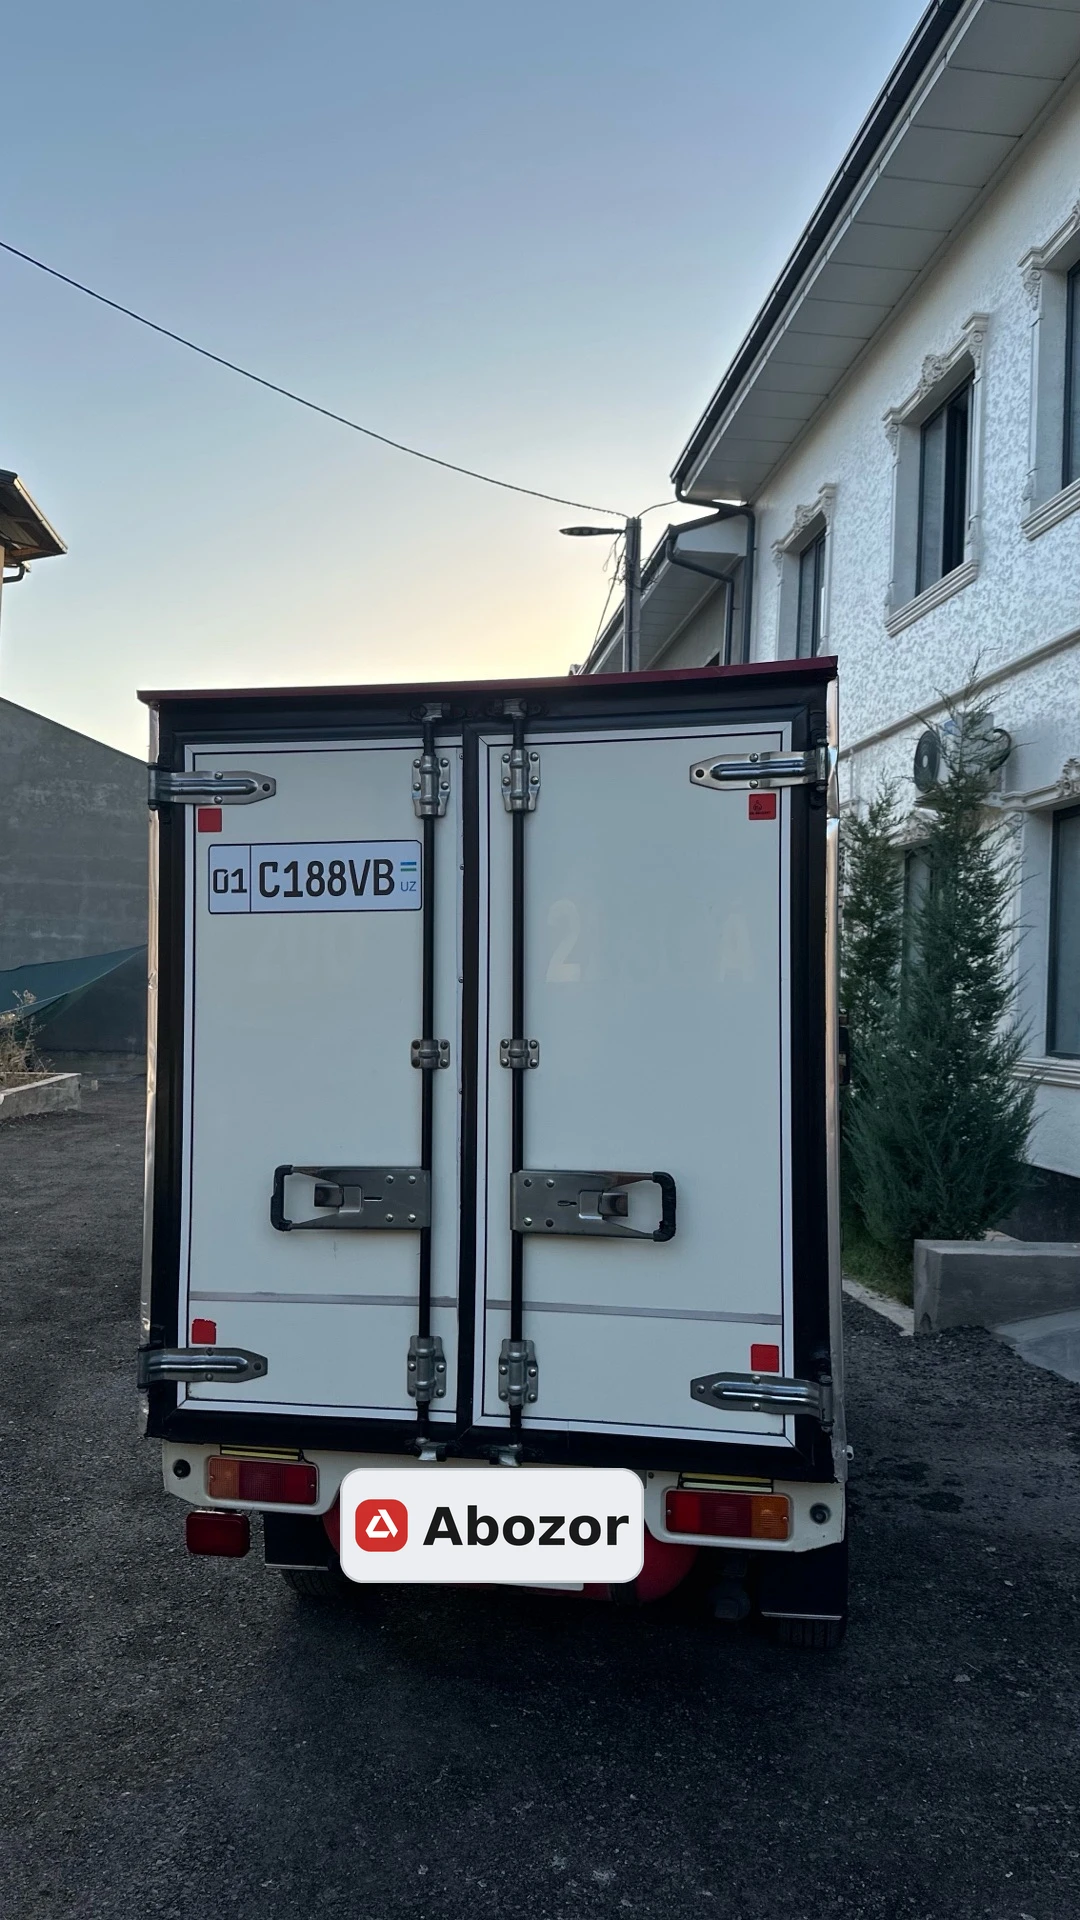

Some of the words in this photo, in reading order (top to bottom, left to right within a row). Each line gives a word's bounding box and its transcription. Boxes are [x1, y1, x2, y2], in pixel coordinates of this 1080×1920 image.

[212, 868, 248, 894] 01
[258, 858, 395, 898] C188VB
[400, 880, 417, 892] UZ
